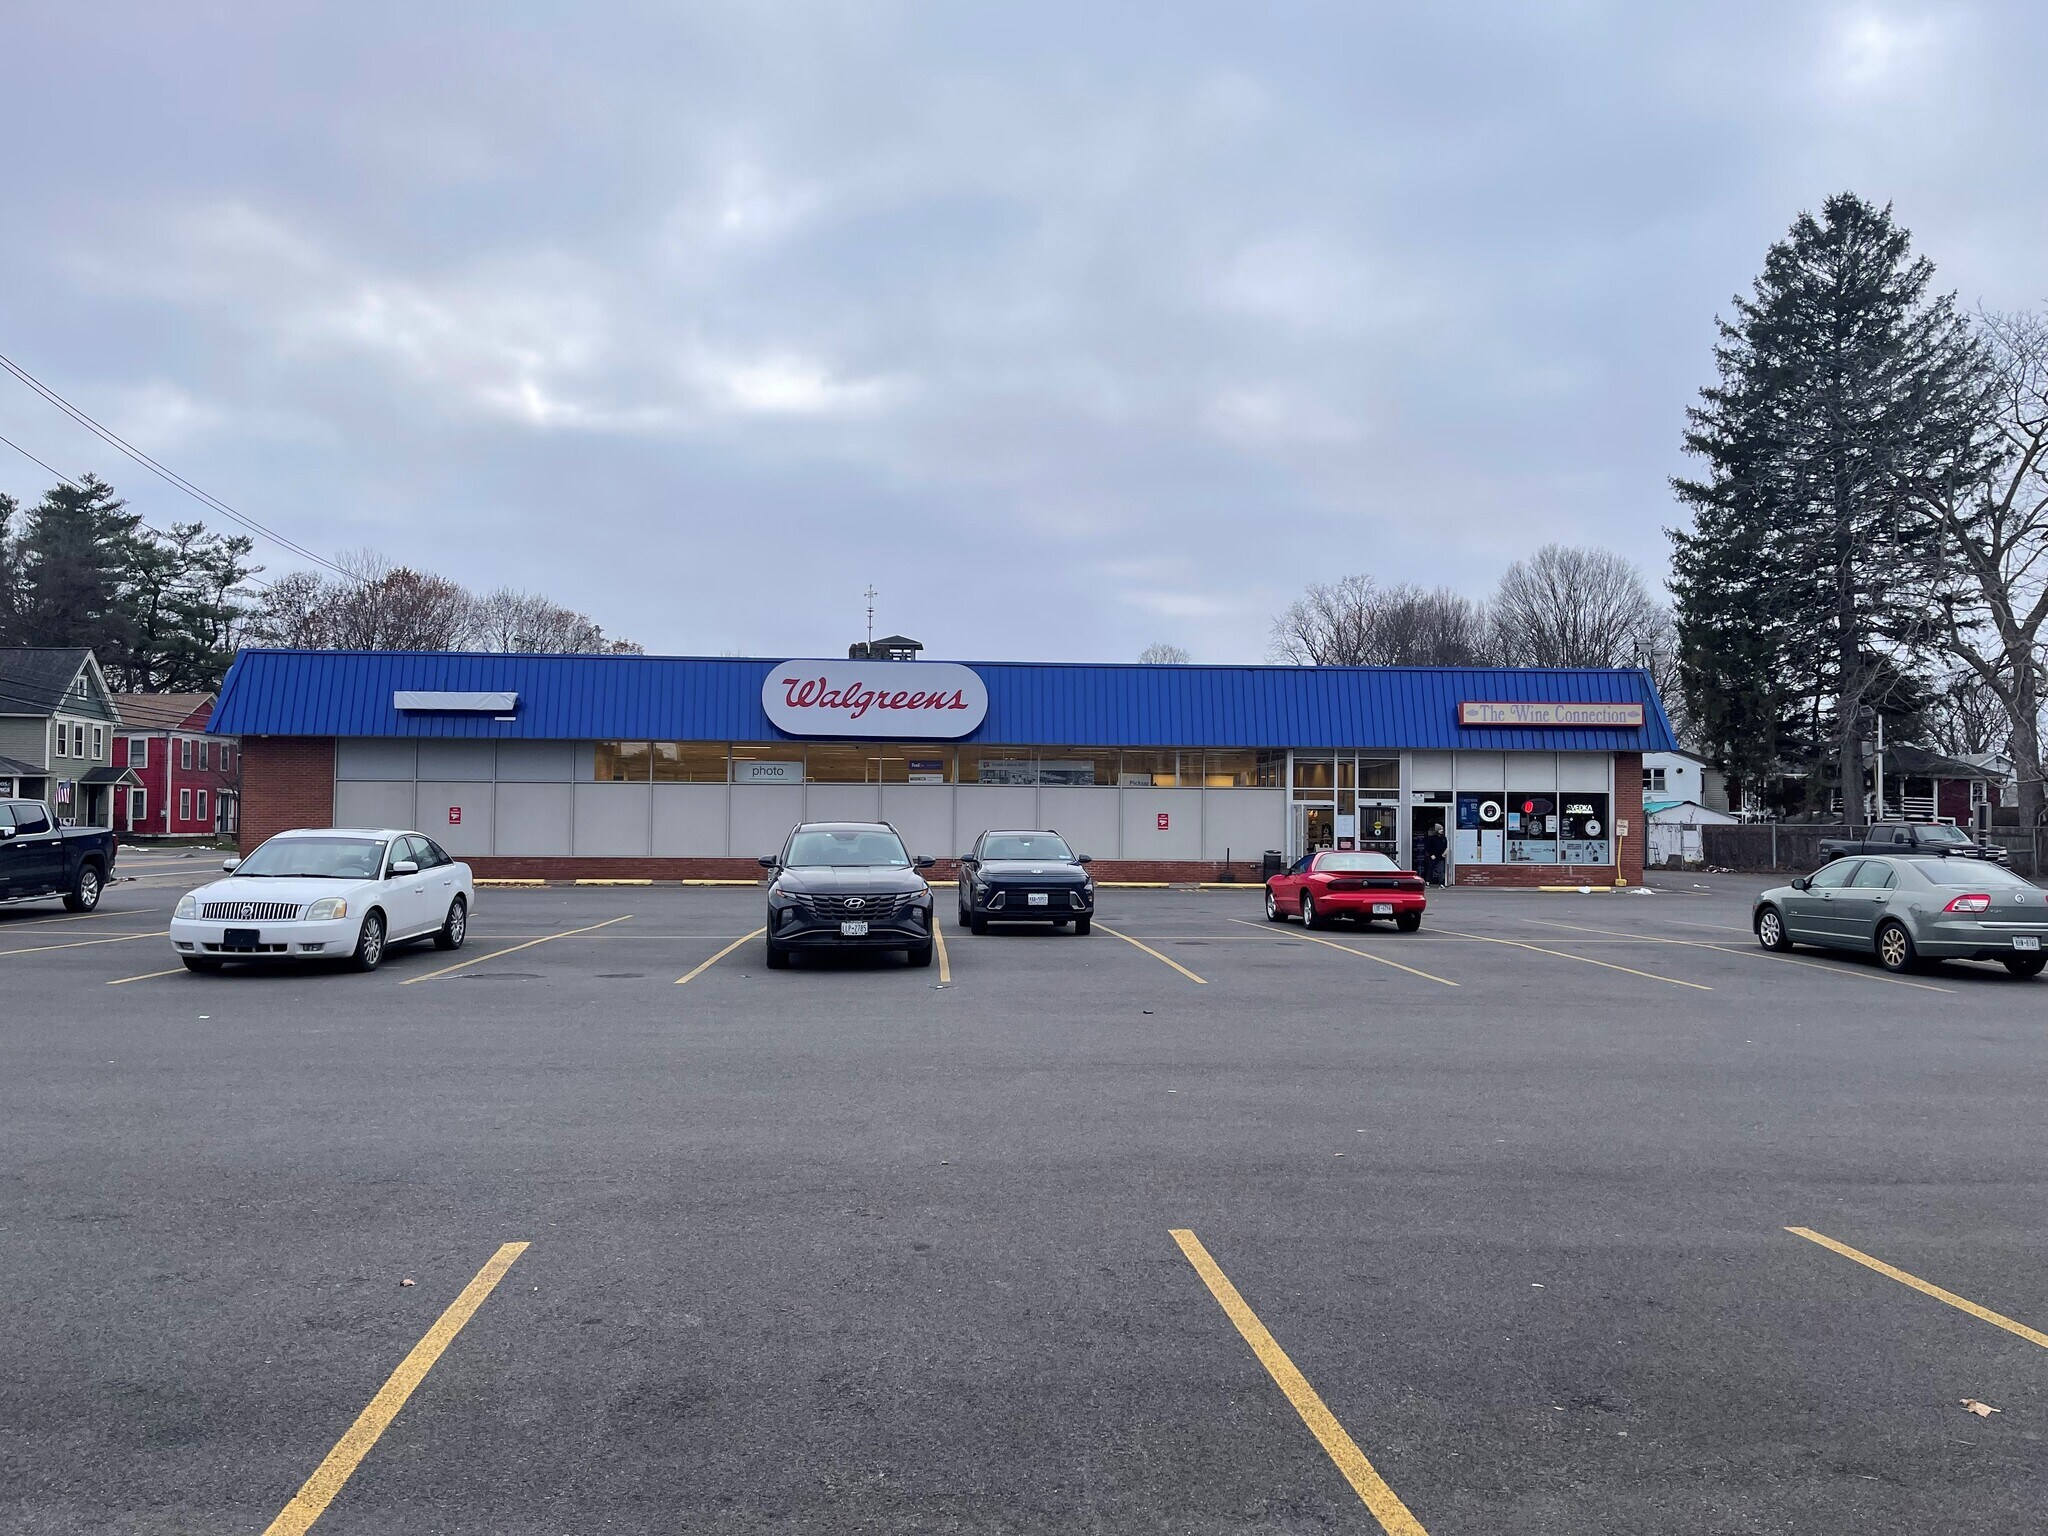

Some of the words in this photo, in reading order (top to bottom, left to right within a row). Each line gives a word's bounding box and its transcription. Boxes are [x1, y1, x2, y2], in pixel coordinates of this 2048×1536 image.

[782, 677, 968, 719] Walgreens
[1479, 704, 1505, 722] The
[1510, 705, 1550, 722] Wine
[1554, 705, 1627, 723] Connection
[752, 765, 784, 778] photo
